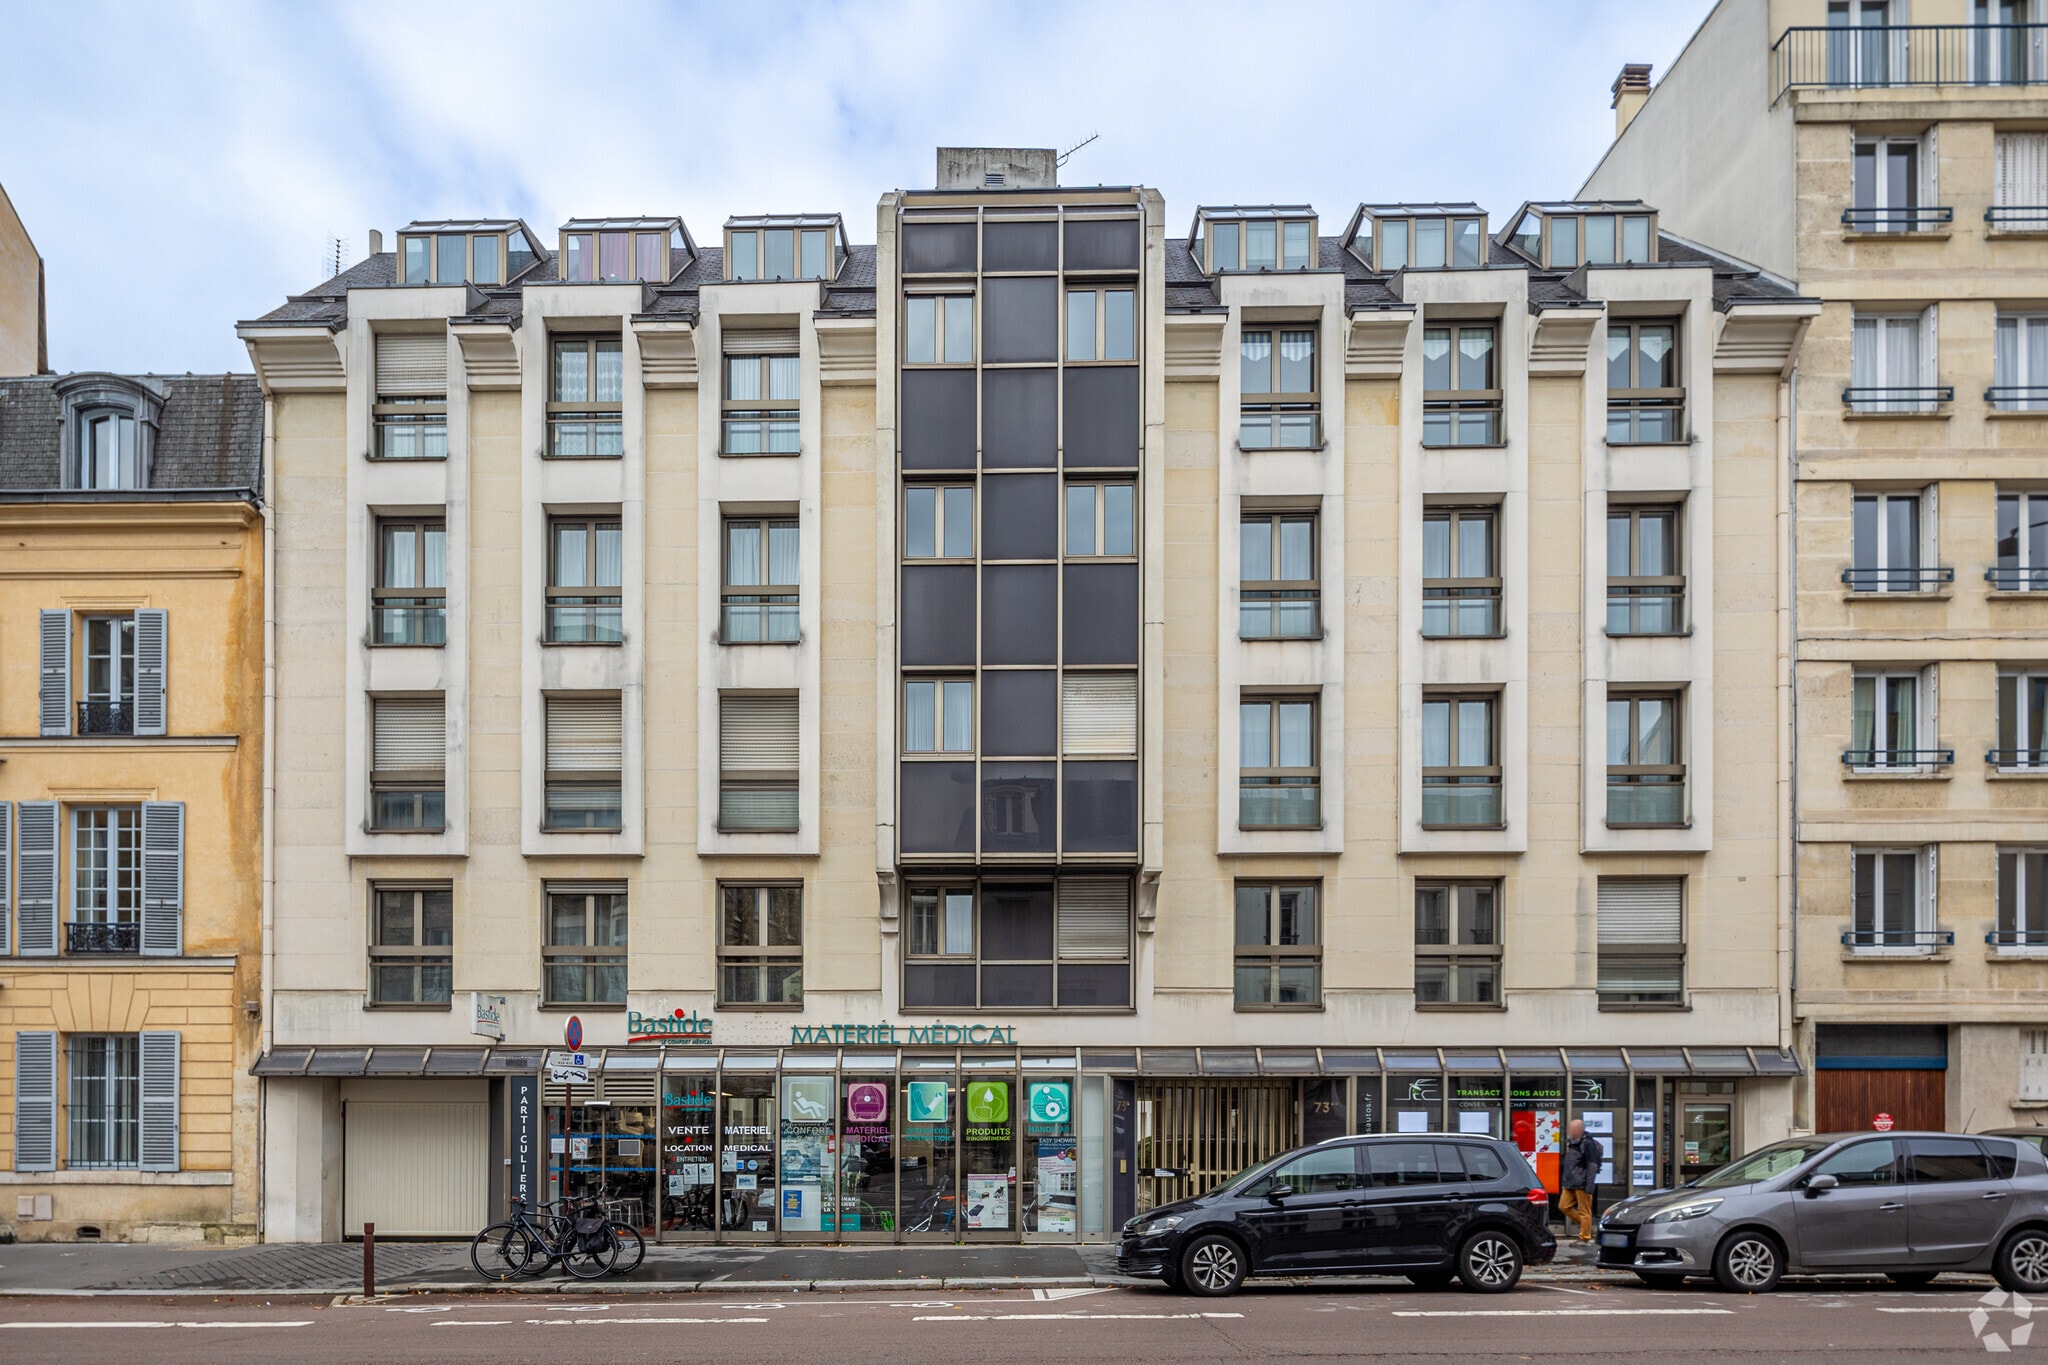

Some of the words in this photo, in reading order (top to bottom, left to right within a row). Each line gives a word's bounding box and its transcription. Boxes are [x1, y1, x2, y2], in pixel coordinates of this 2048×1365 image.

[477, 1004, 500, 1022] Bastide
[628, 1008, 713, 1034] Bastide
[908, 1019, 1018, 1045] MÉDICAL
[664, 1090, 713, 1106] Bastide
[668, 1126, 710, 1135] VENTE
[724, 1126, 772, 1135] MATERIEL
[966, 1128, 1011, 1136] PRODUITS
[520, 1086, 529, 1201] PARTICULIERS
